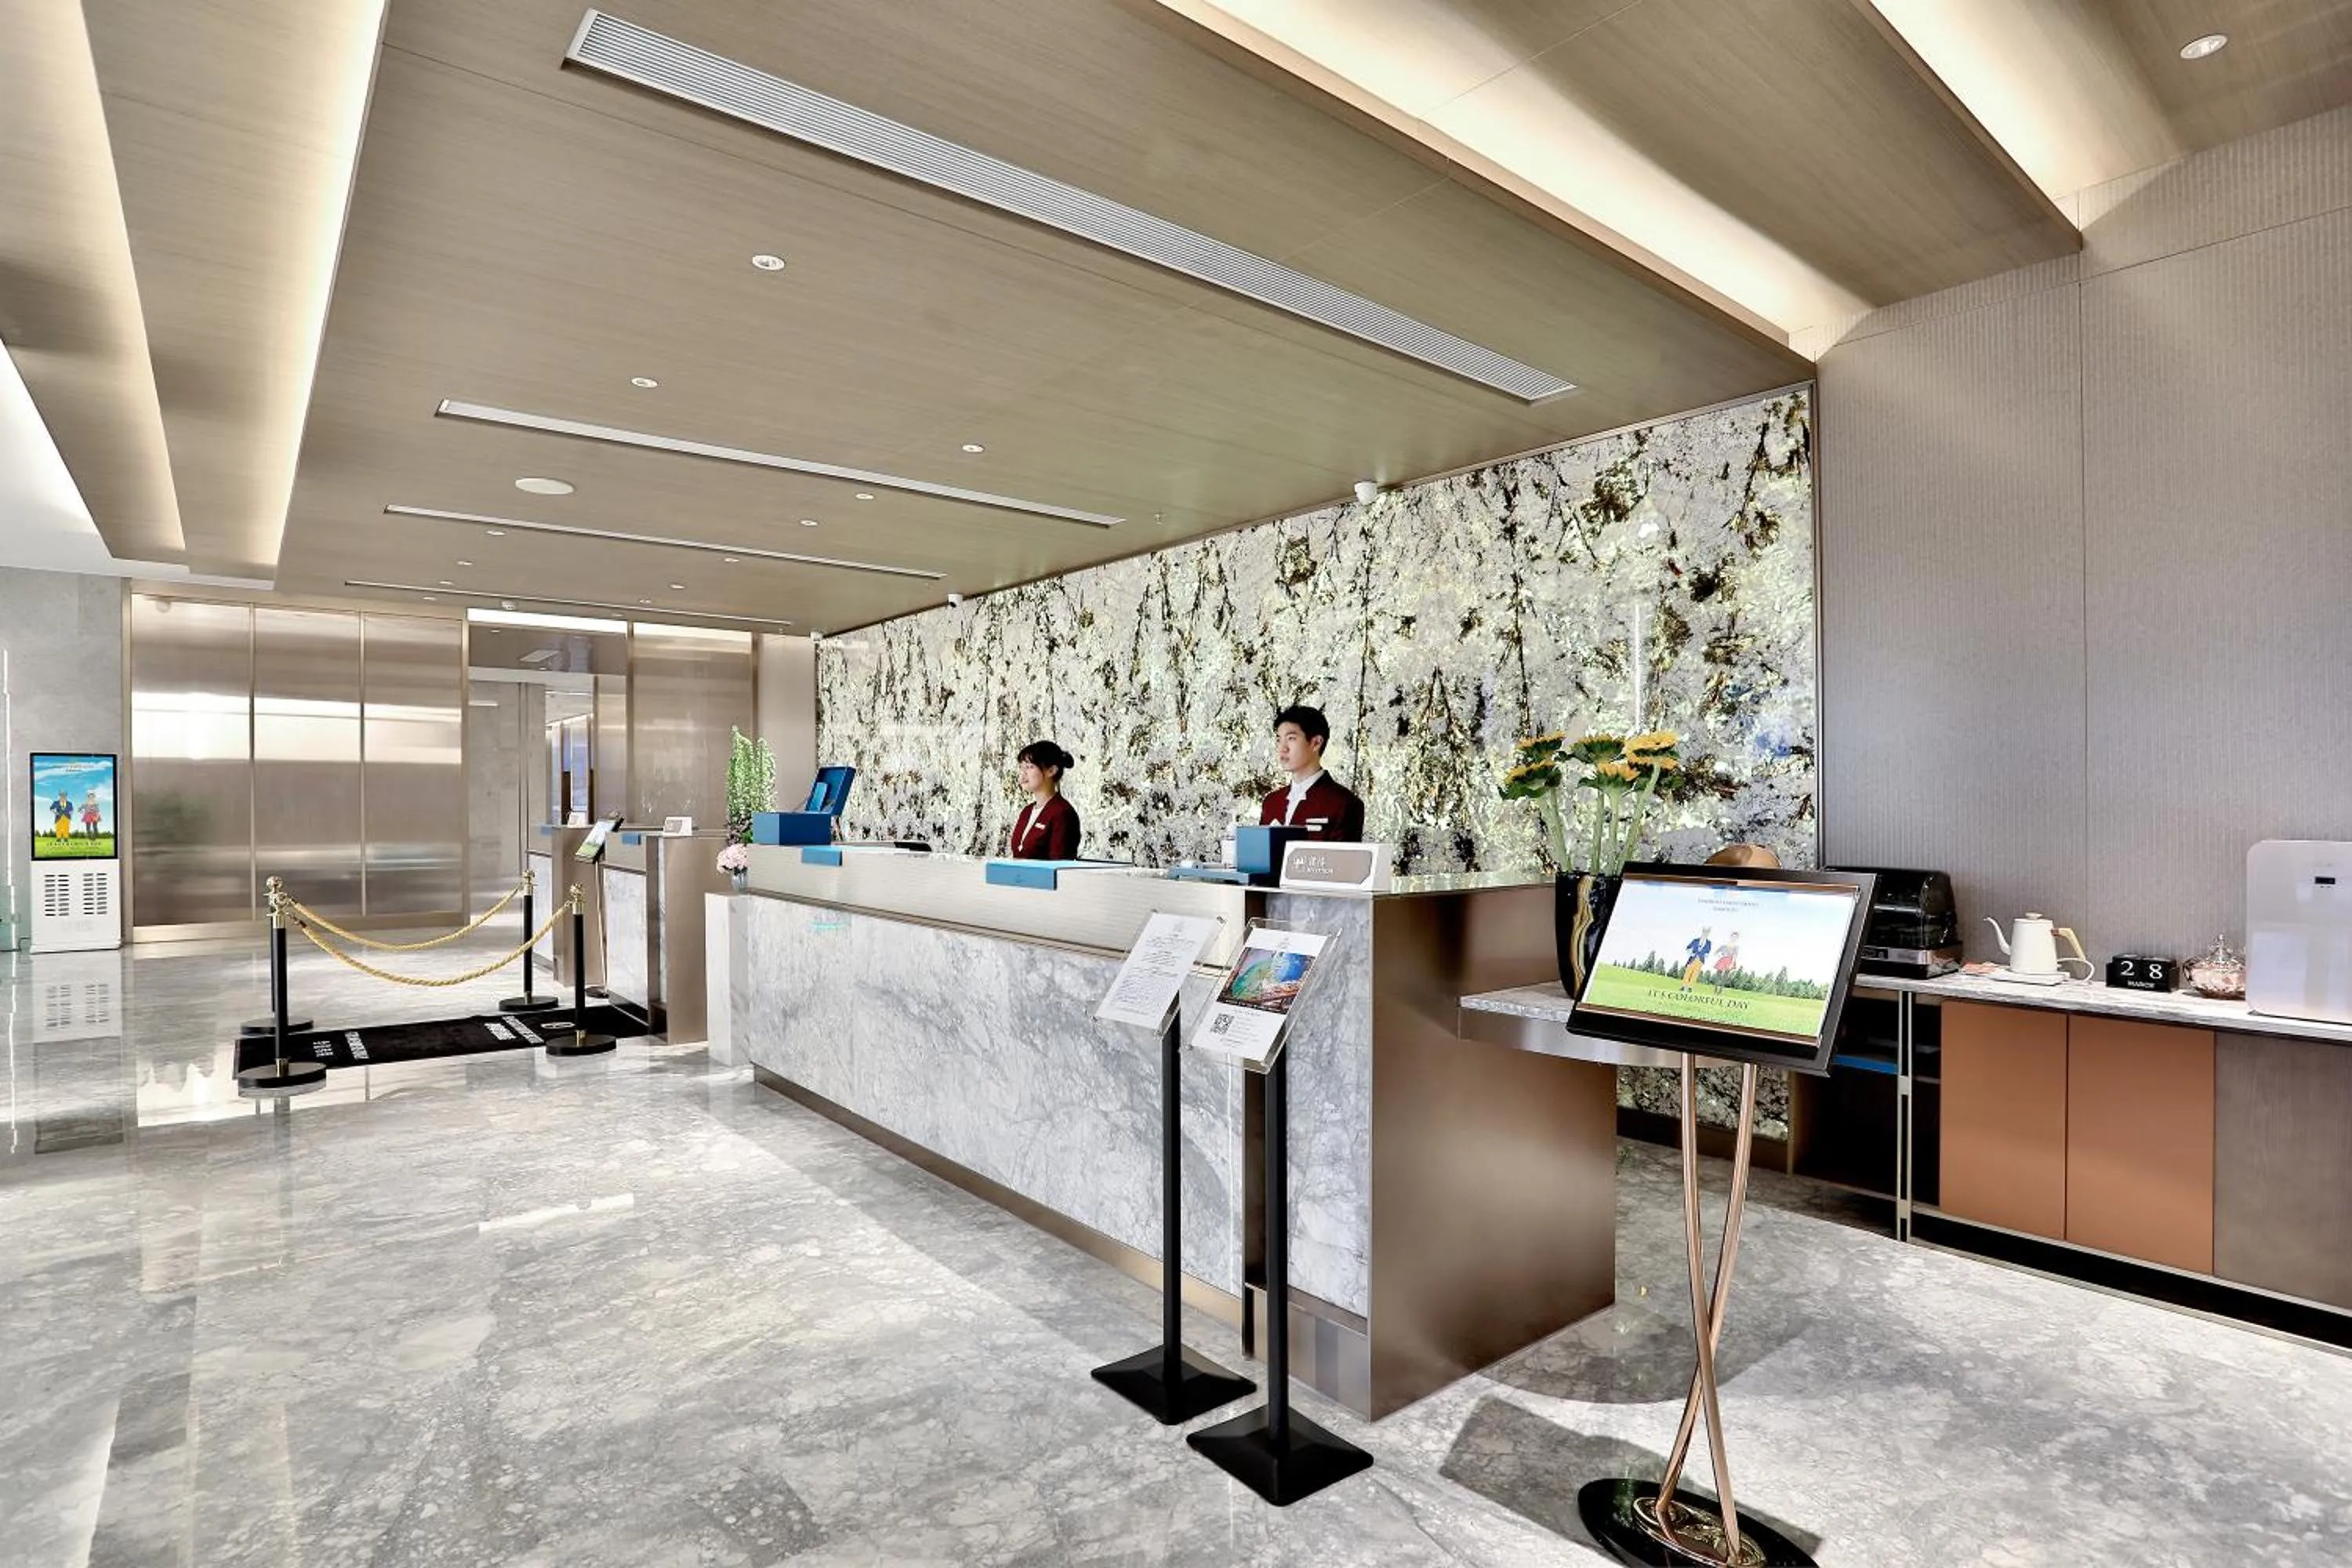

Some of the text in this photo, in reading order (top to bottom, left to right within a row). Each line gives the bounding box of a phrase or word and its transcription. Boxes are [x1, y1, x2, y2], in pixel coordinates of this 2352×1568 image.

[2120, 960, 2163, 979] 2 8
[1727, 1000, 1751, 1010] DAY
